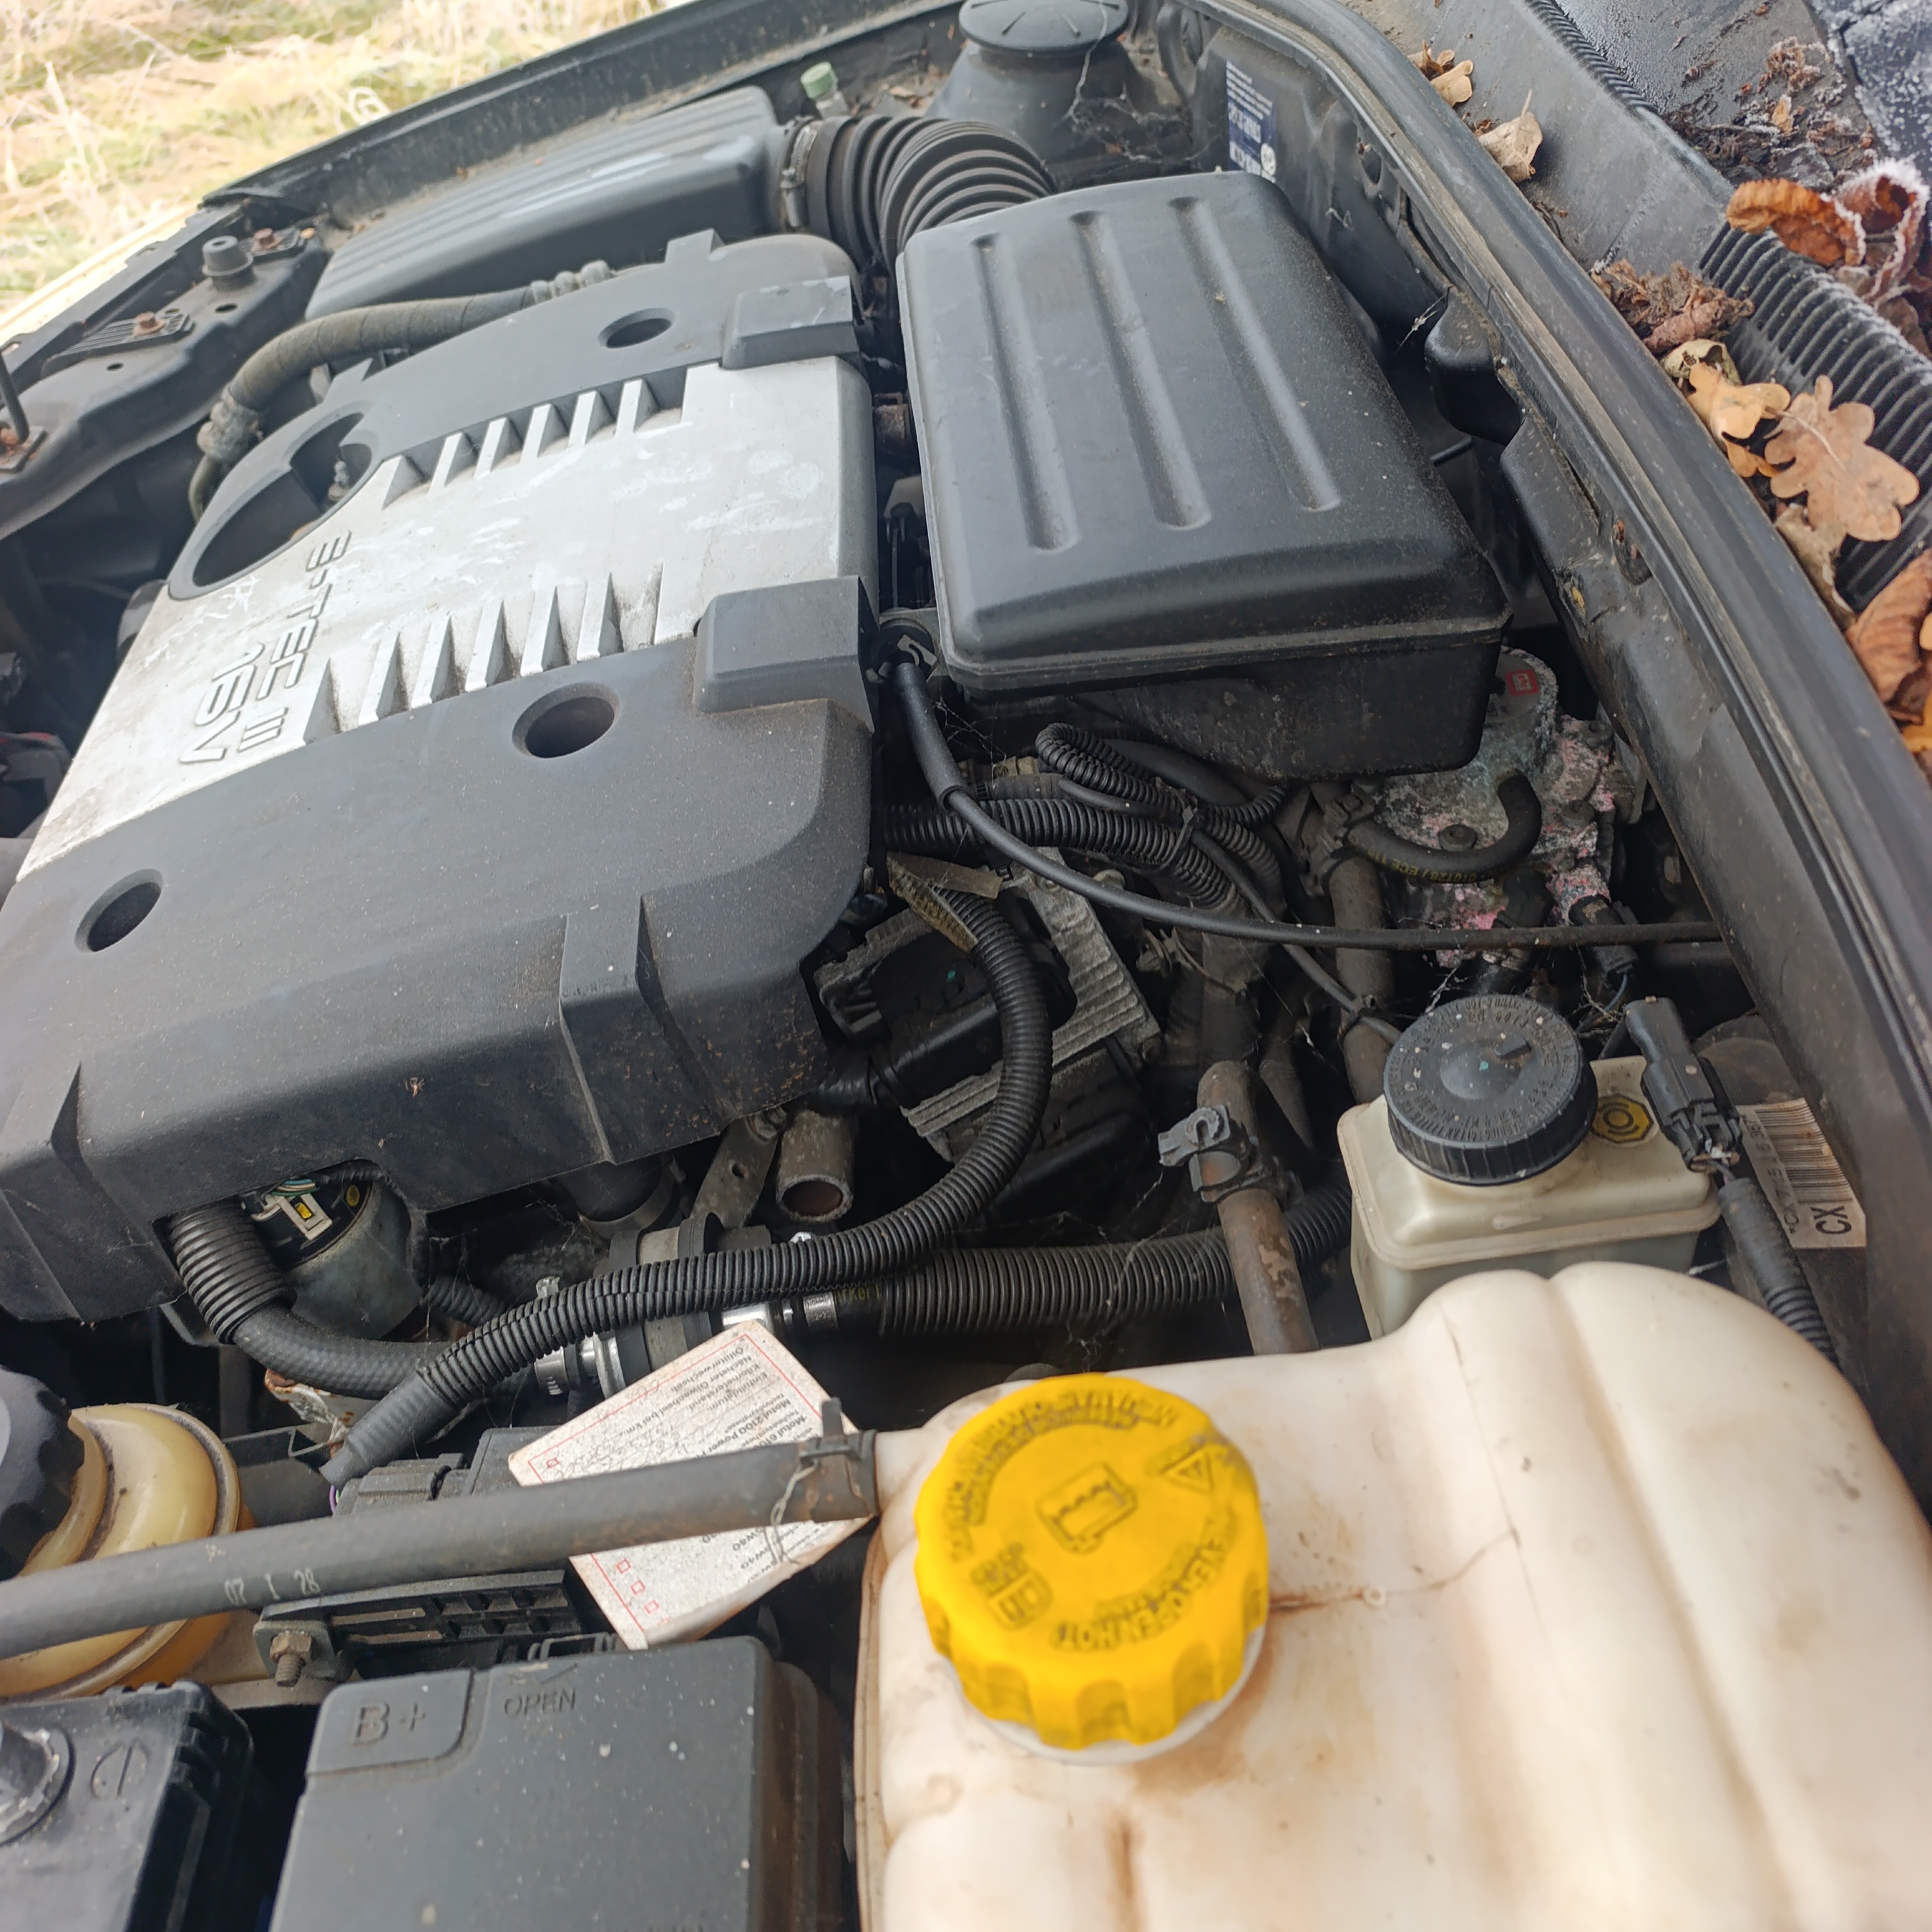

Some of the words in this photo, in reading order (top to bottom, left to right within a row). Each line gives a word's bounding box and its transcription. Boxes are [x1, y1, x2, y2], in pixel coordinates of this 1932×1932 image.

[177, 642, 267, 763] 16V
[1810, 1205, 1852, 1235] CX
[763, 1398, 792, 1420] Motul
[738, 1414, 764, 1435] 2100
[778, 1415, 808, 1439] Motul
[293, 1567, 321, 1596] 28
[504, 1688, 577, 1718] OPEN
